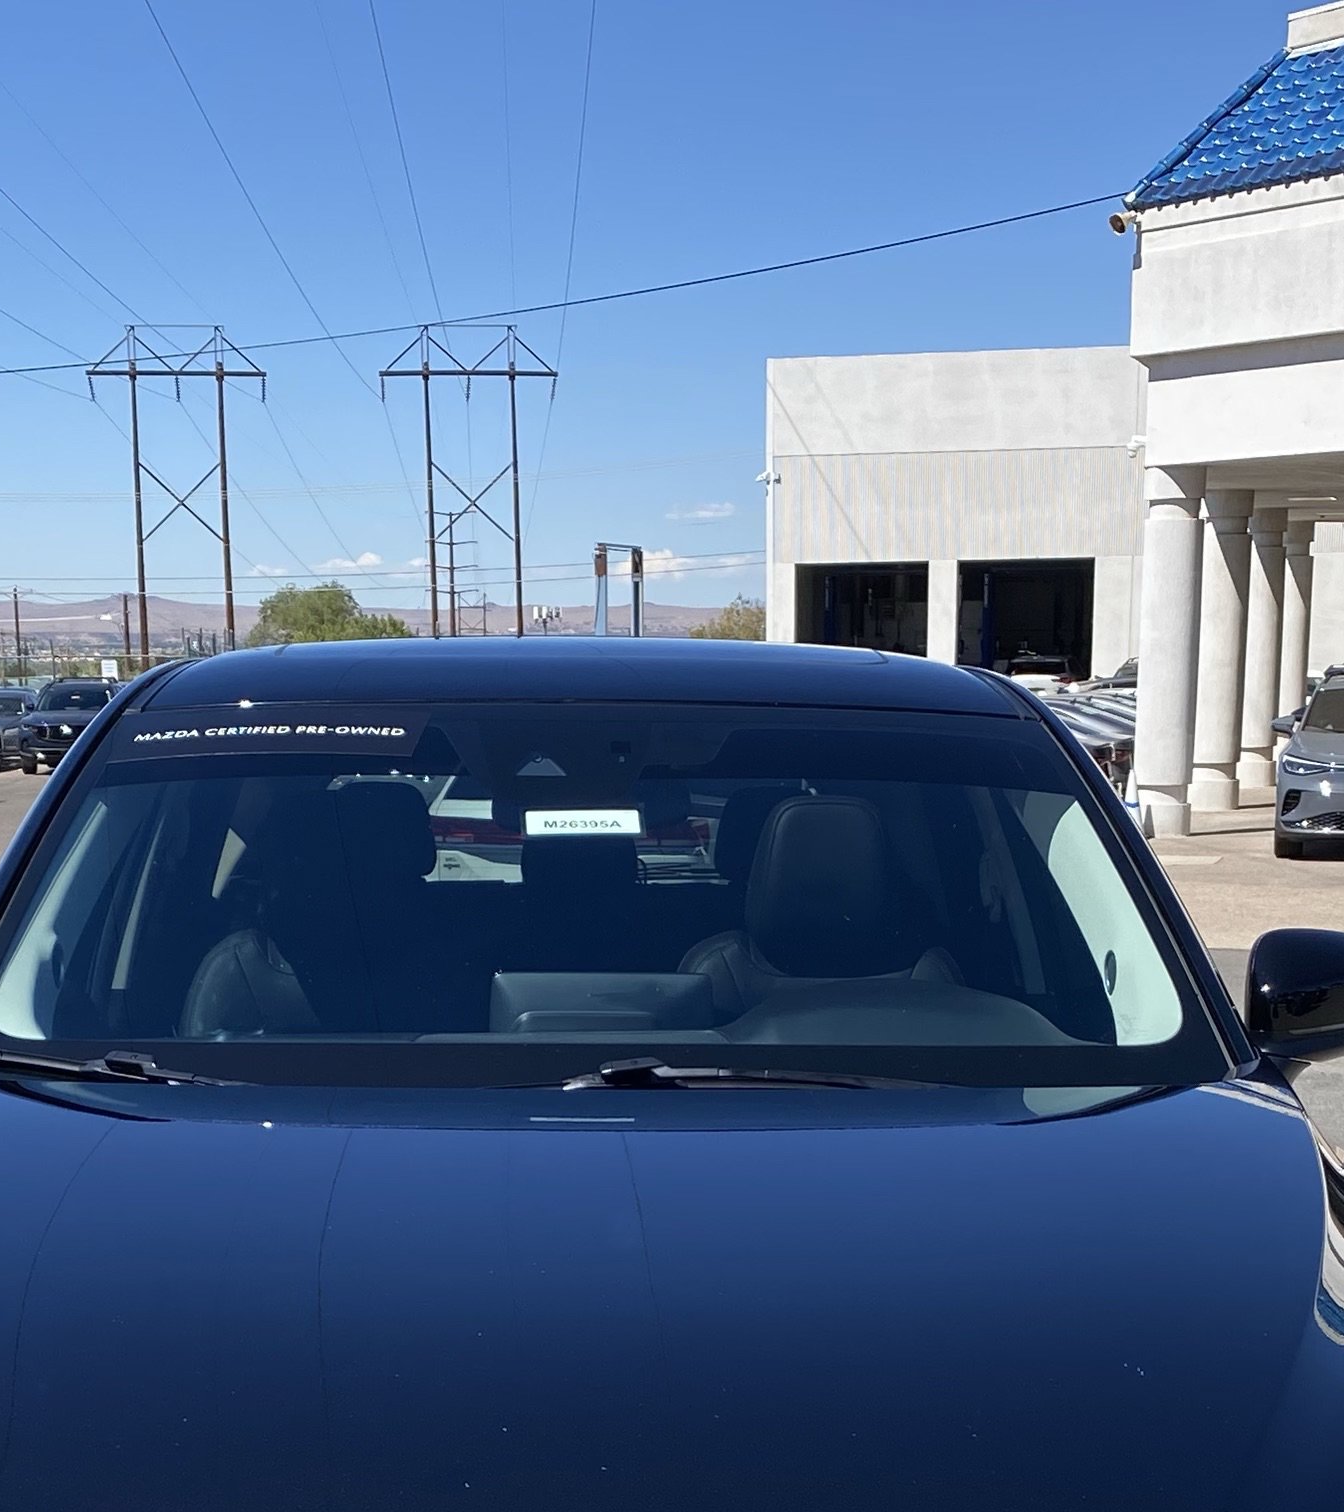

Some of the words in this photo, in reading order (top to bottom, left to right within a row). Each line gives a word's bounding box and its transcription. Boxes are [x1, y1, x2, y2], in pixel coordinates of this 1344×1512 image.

[133, 729, 199, 742] MAZDA
[204, 726, 291, 736] CERTIFIED
[295, 725, 406, 736] PRE-OWNED
[543, 820, 622, 829] M26395A
